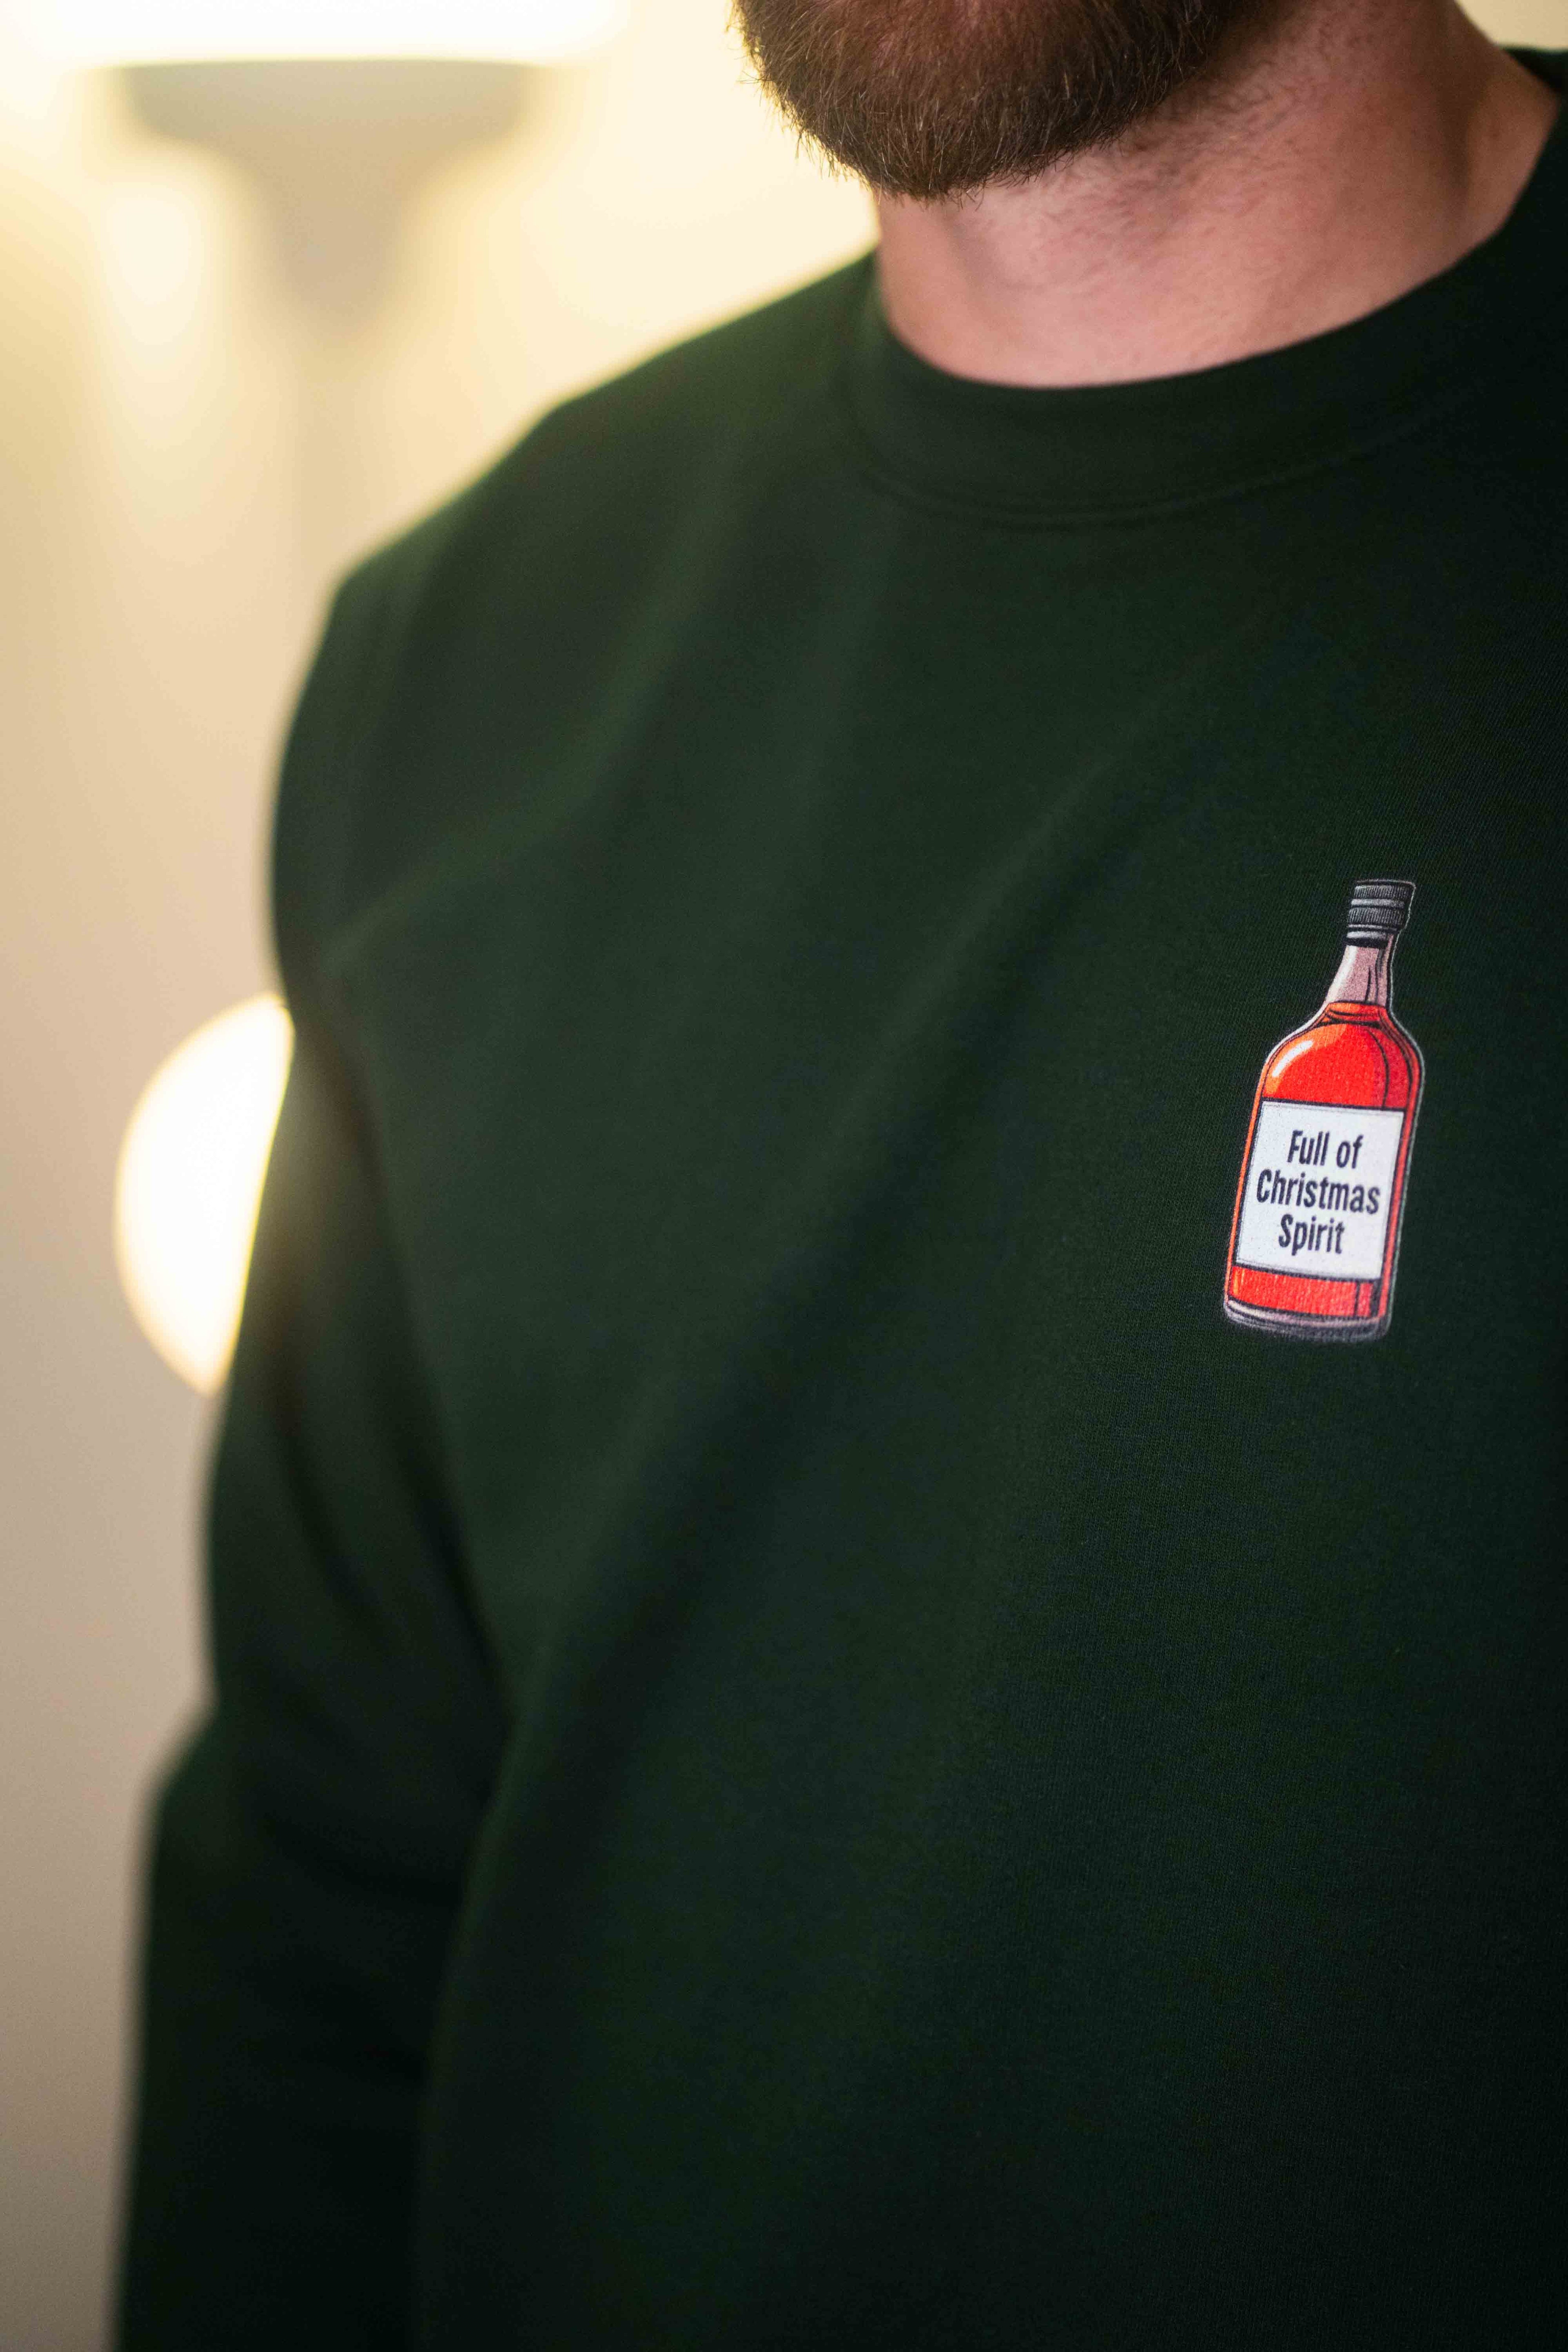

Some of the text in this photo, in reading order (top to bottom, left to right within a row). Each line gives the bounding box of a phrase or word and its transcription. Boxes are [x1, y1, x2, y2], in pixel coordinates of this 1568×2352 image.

[1287, 1130, 1363, 1169] Full of
[1256, 1169, 1380, 1215] Christmas
[1278, 1214, 1345, 1256] Spirit
